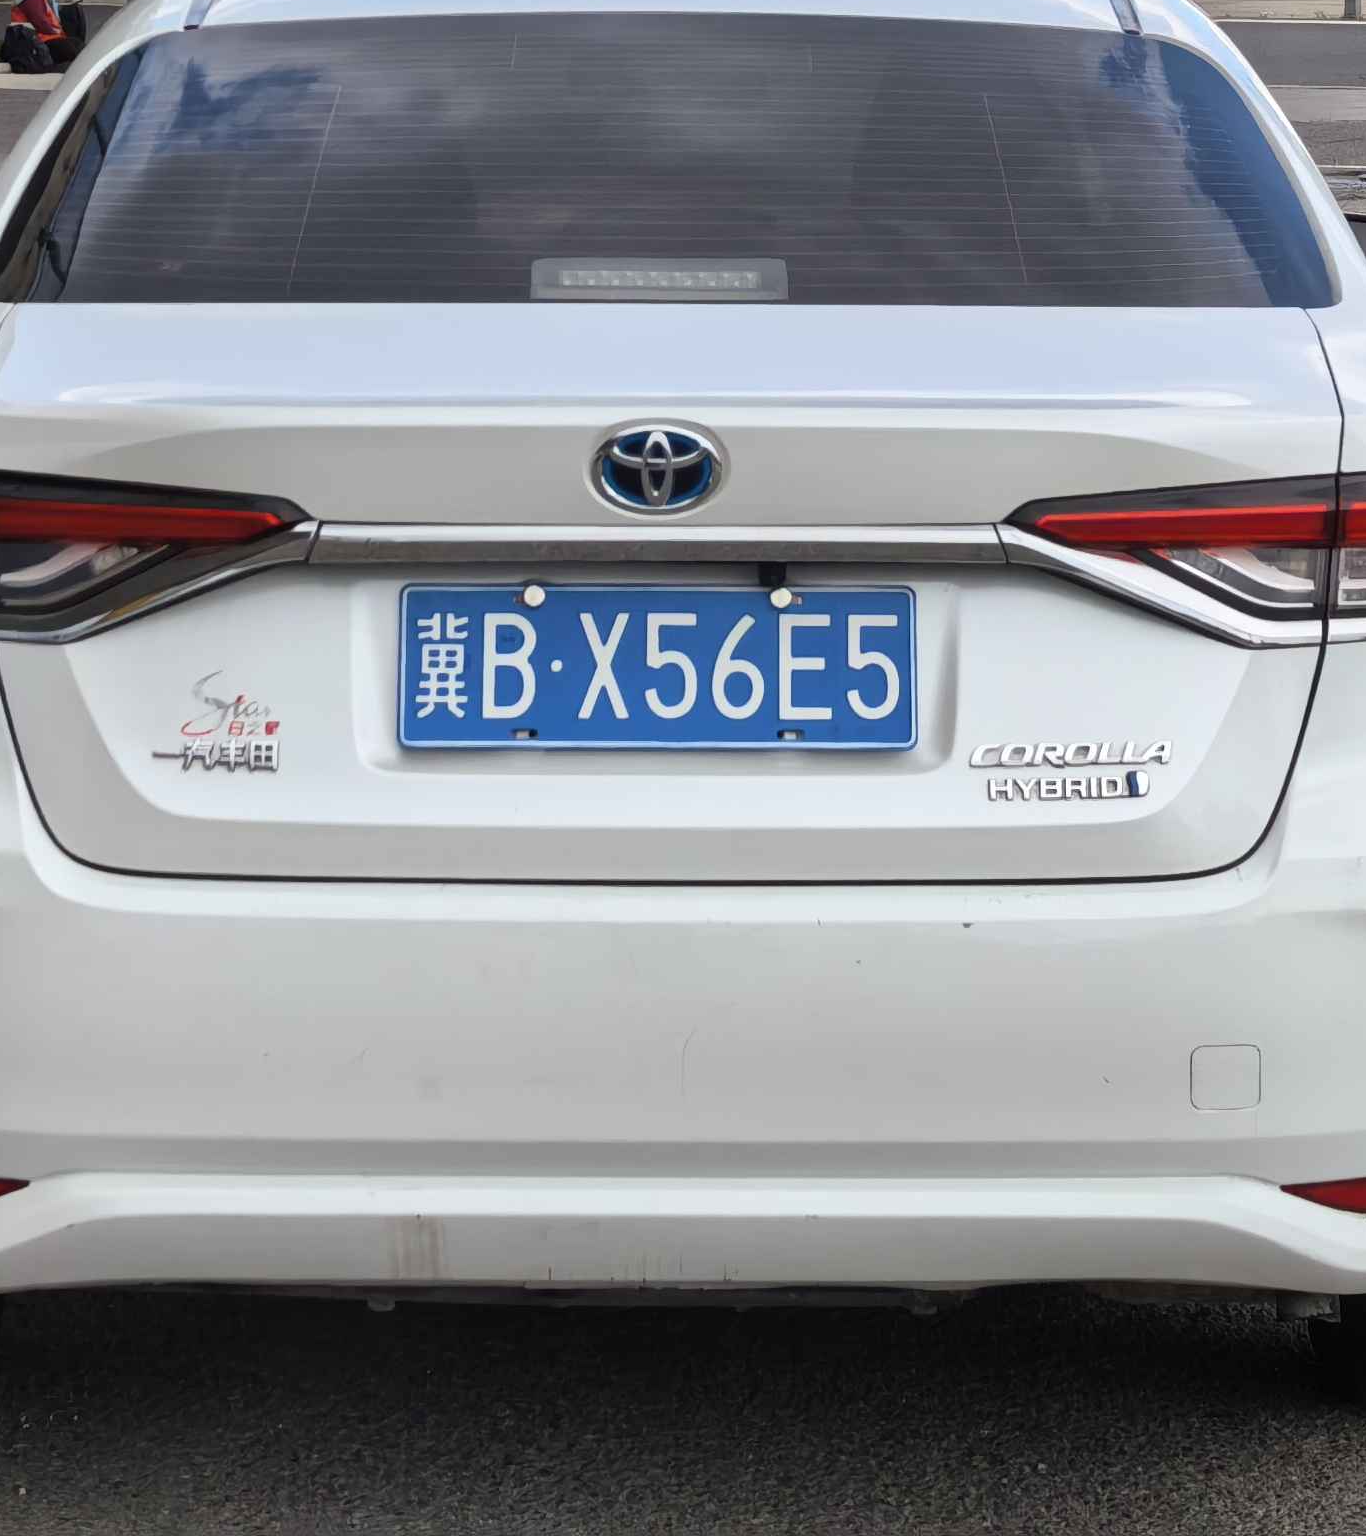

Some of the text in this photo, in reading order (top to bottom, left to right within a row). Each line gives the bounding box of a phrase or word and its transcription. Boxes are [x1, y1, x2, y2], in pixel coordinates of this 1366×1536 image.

[416, 612, 901, 721] 冀B·X56E5
[969, 740, 1173, 768] COROLLA
[988, 775, 1123, 801] HYBRID
